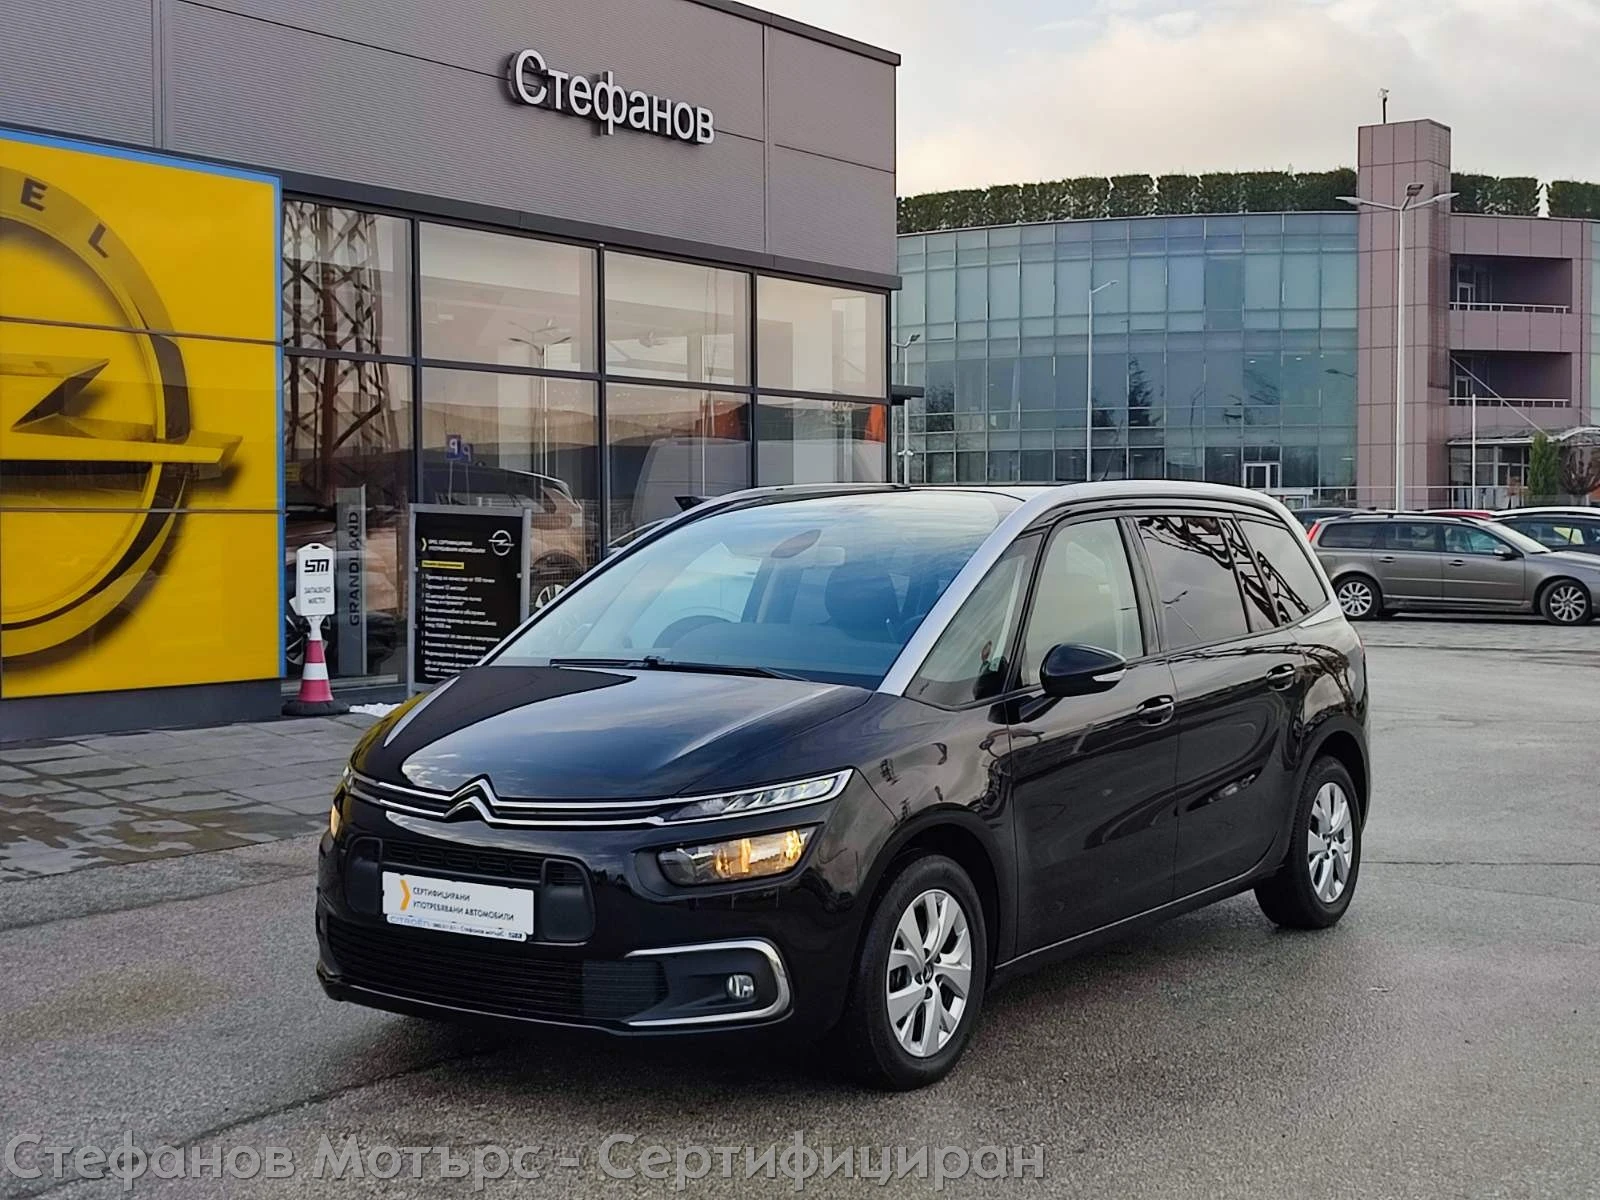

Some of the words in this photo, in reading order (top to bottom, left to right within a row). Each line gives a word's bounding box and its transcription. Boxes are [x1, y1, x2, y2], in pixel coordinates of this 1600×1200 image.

[515, 49, 715, 144] Стефанов
[349, 511, 360, 626] GRANDLAND
[413, 887, 470, 901] СЕРТИФИЦИРАНИ
[413, 901, 463, 914] УПОТРЕБЯВАНИ
[465, 908, 514, 921] АВТОМОБИЛИ
